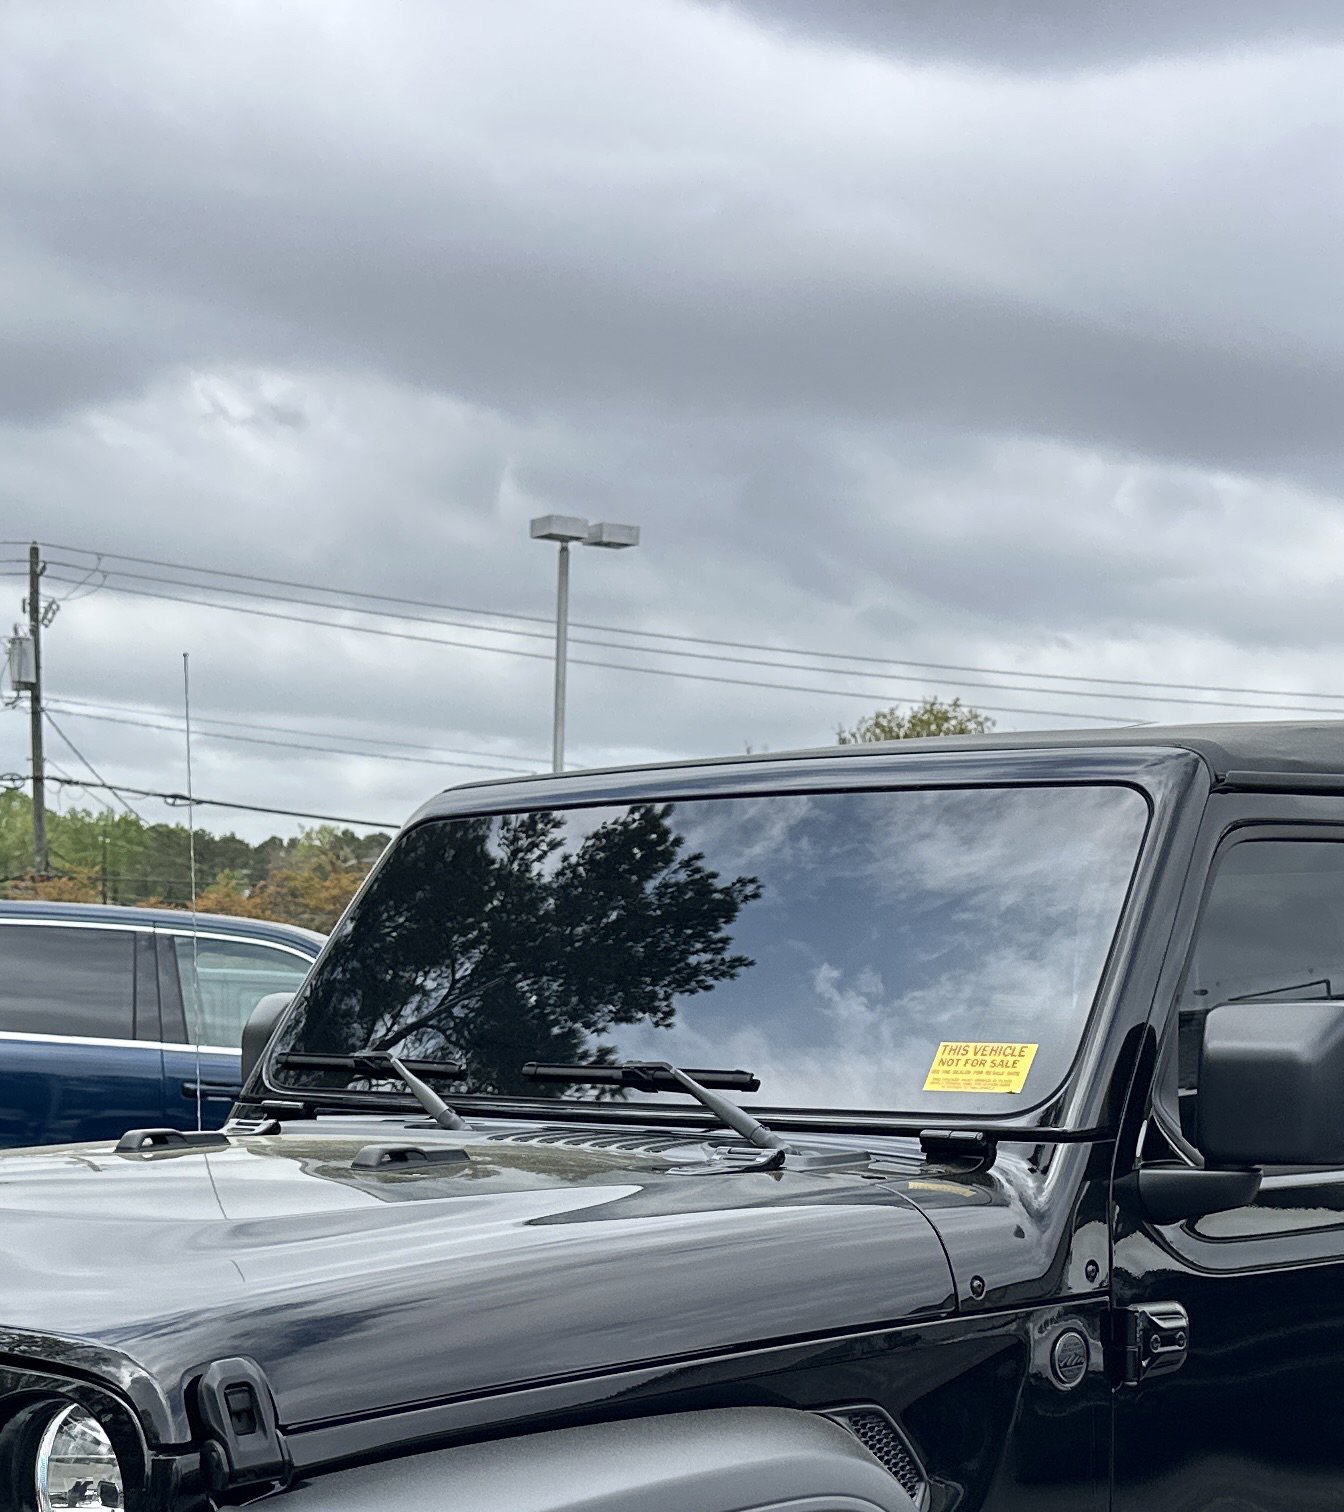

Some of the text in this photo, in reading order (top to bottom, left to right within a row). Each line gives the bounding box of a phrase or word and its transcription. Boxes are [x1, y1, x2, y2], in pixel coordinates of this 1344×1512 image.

[942, 1045, 1028, 1057] THIS VEHICLE
[938, 1058, 1020, 1068] NOT FOR SALE
